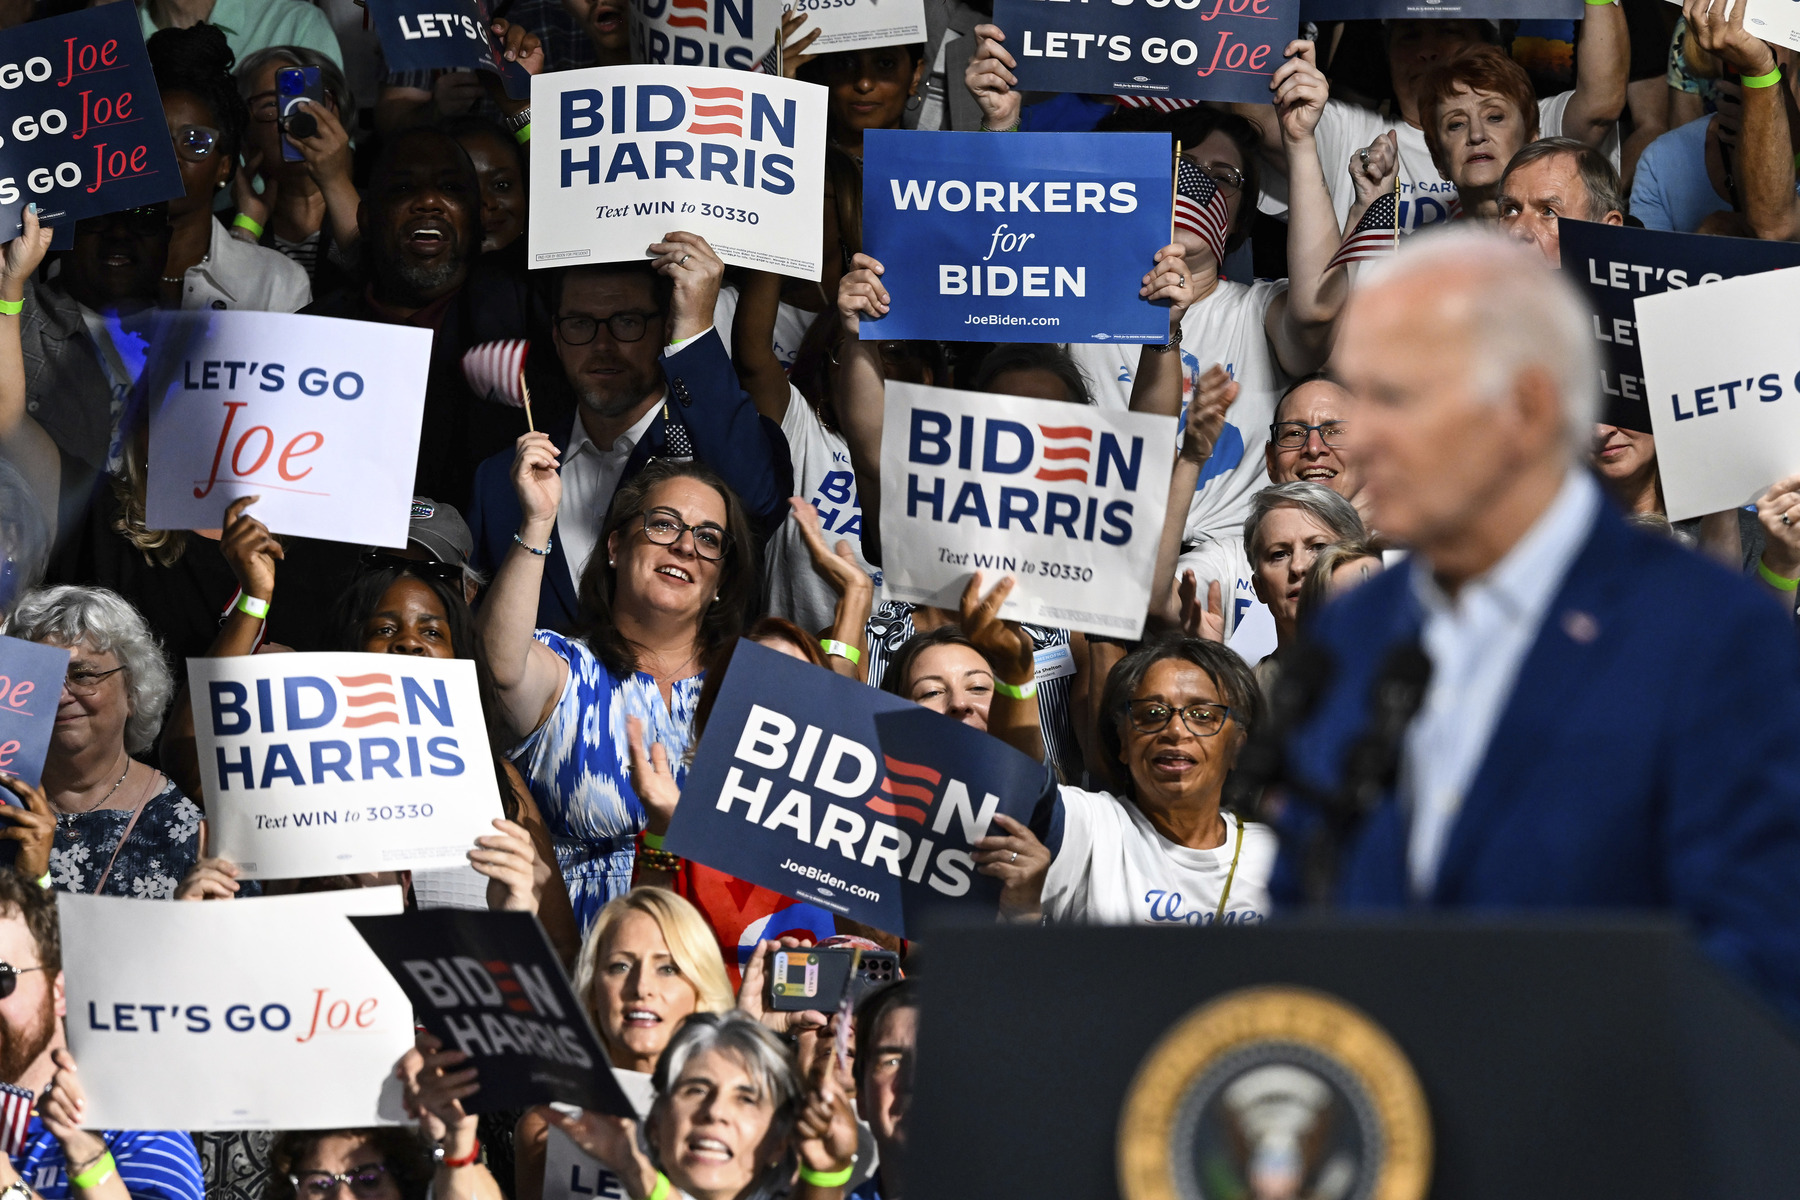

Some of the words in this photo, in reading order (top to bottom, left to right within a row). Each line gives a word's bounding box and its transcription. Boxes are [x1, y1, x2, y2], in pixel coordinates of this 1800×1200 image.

[398, 13, 477, 40] LET'S
[0, 56, 52, 90] GO
[57, 37, 118, 87] Joe
[1023, 30, 1132, 61] LET'S
[1141, 37, 1198, 66] GO
[1197, 31, 1272, 77] Joe
[12, 109, 68, 142] GO
[72, 90, 133, 140] Joe
[560, 84, 797, 149] BIDEN
[27, 162, 82, 194] GO
[87, 143, 148, 193] Joe
[560, 140, 796, 196] HARRIS
[595, 204, 630, 220] Text
[634, 200, 675, 216] WIN
[680, 201, 696, 214] to
[701, 202, 760, 225] 30330
[890, 179, 1138, 213] WORKERS
[982, 224, 1035, 261] for
[939, 265, 1086, 297] BIDEN
[964, 314, 1060, 326] JoeBiden.com
[1593, 315, 1637, 346] LE
[184, 360, 285, 392] LET'S
[298, 367, 365, 401] GO
[1600, 369, 1645, 401] LE
[1671, 373, 1783, 422] LET'S
[193, 401, 325, 499] Joe
[908, 407, 1144, 492] BIDEN
[906, 473, 1134, 546] HARRIS
[938, 547, 969, 566] Text
[973, 553, 1017, 572] WIN
[1021, 559, 1036, 574] to
[1039, 561, 1094, 583] 30330
[208, 672, 455, 737] BIDEN
[215, 735, 466, 791] HARRIS
[733, 703, 1000, 846] BIDEN
[255, 813, 290, 830] Text
[293, 809, 338, 827] WIN
[344, 809, 361, 823] to
[366, 803, 434, 822] 30330
[715, 765, 976, 898] HARRIS
[780, 857, 880, 903] JoeBiden.com
[402, 956, 566, 1020] BIDEN
[88, 1000, 211, 1033] LET'S
[224, 1003, 292, 1033] GO
[295, 987, 379, 1043] Joe
[442, 1013, 595, 1070] HARRIS
